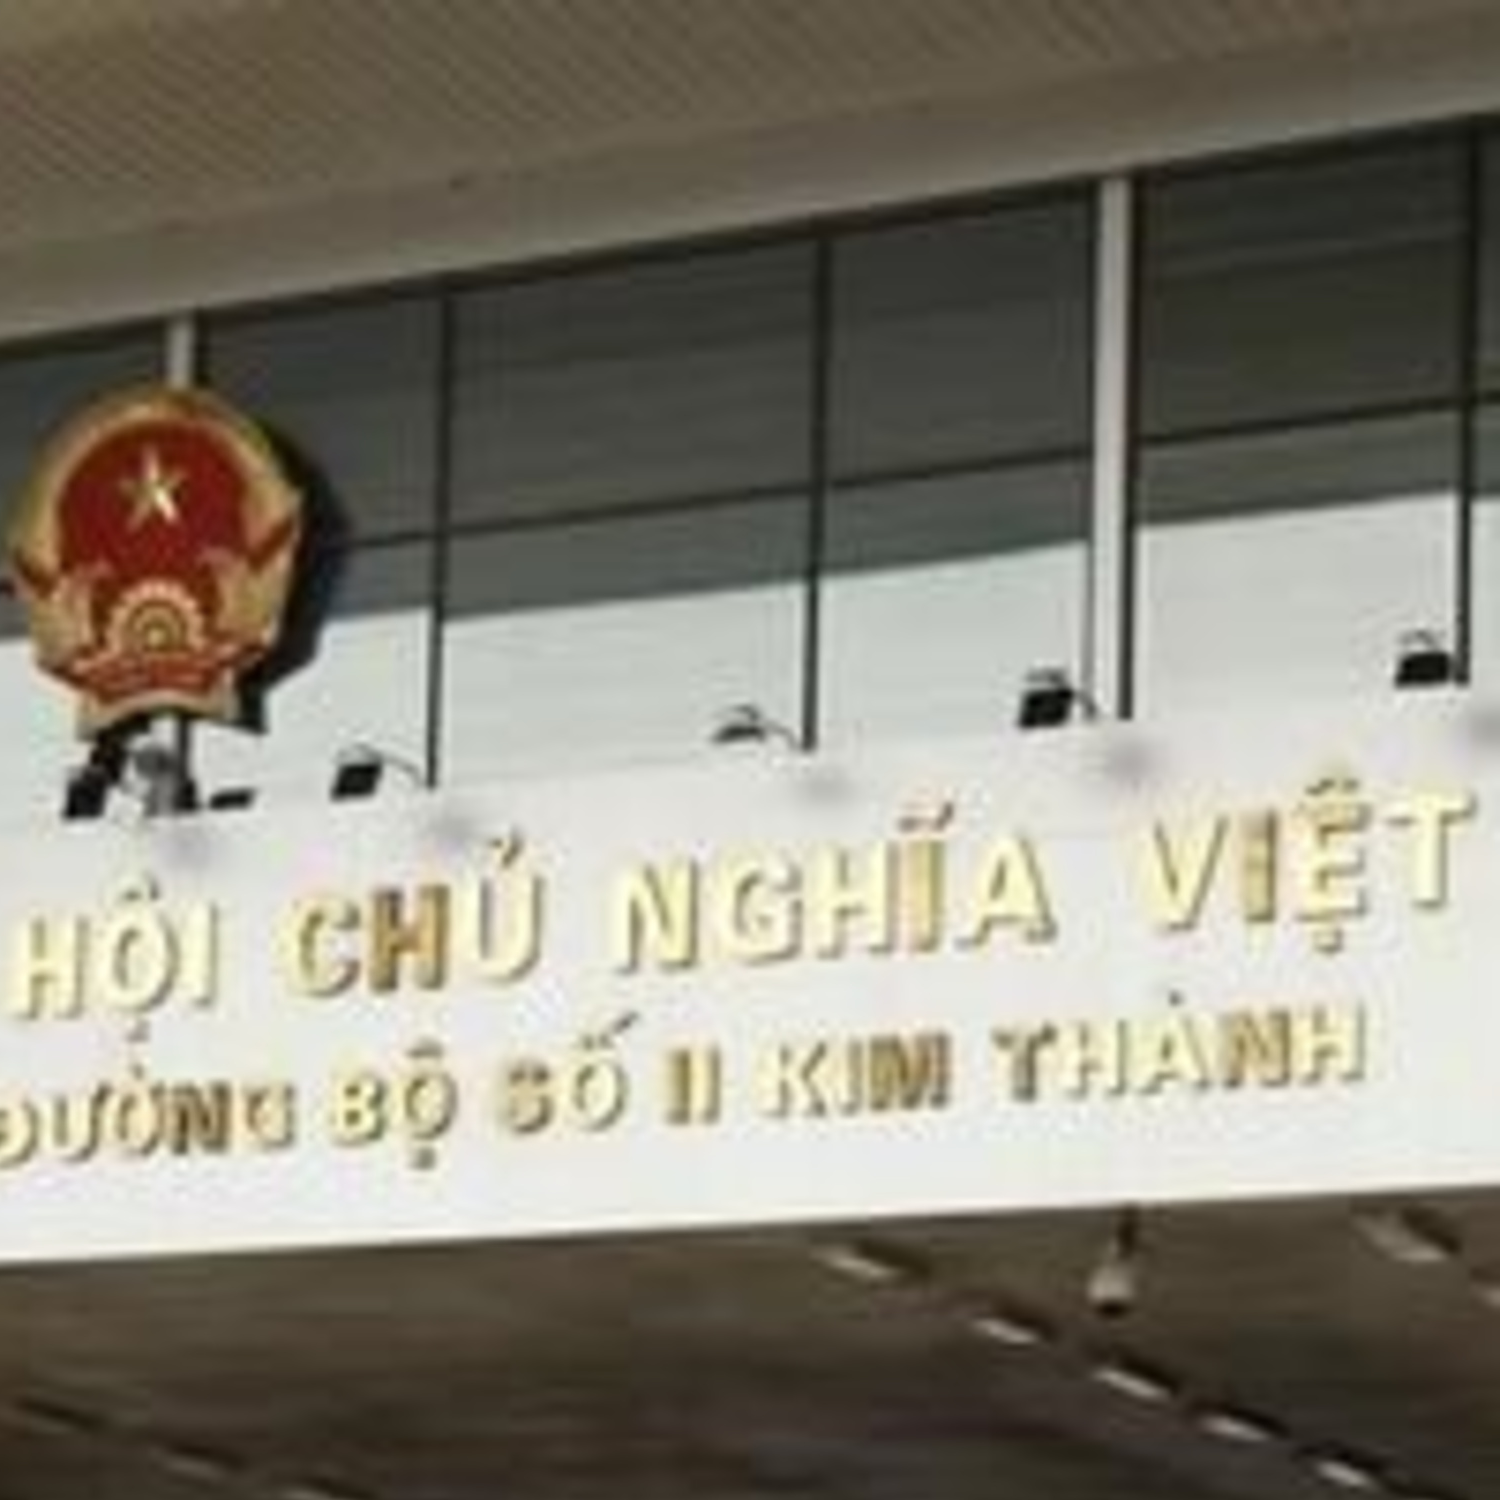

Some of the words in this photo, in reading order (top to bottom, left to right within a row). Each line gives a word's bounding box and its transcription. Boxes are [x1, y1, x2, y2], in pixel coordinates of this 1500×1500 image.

[6, 872, 222, 1044] HỘI
[276, 830, 546, 1000] CHỦ
[606, 800, 1060, 976] NGHĨA
[1132, 776, 1478, 954] VIỆT
[330, 1036, 460, 1172] BỘ
[502, 1012, 640, 1136] SỐ
[664, 1046, 722, 1126] II
[764, 1028, 954, 1118] KIM
[988, 988, 1370, 1104] THÀNH
